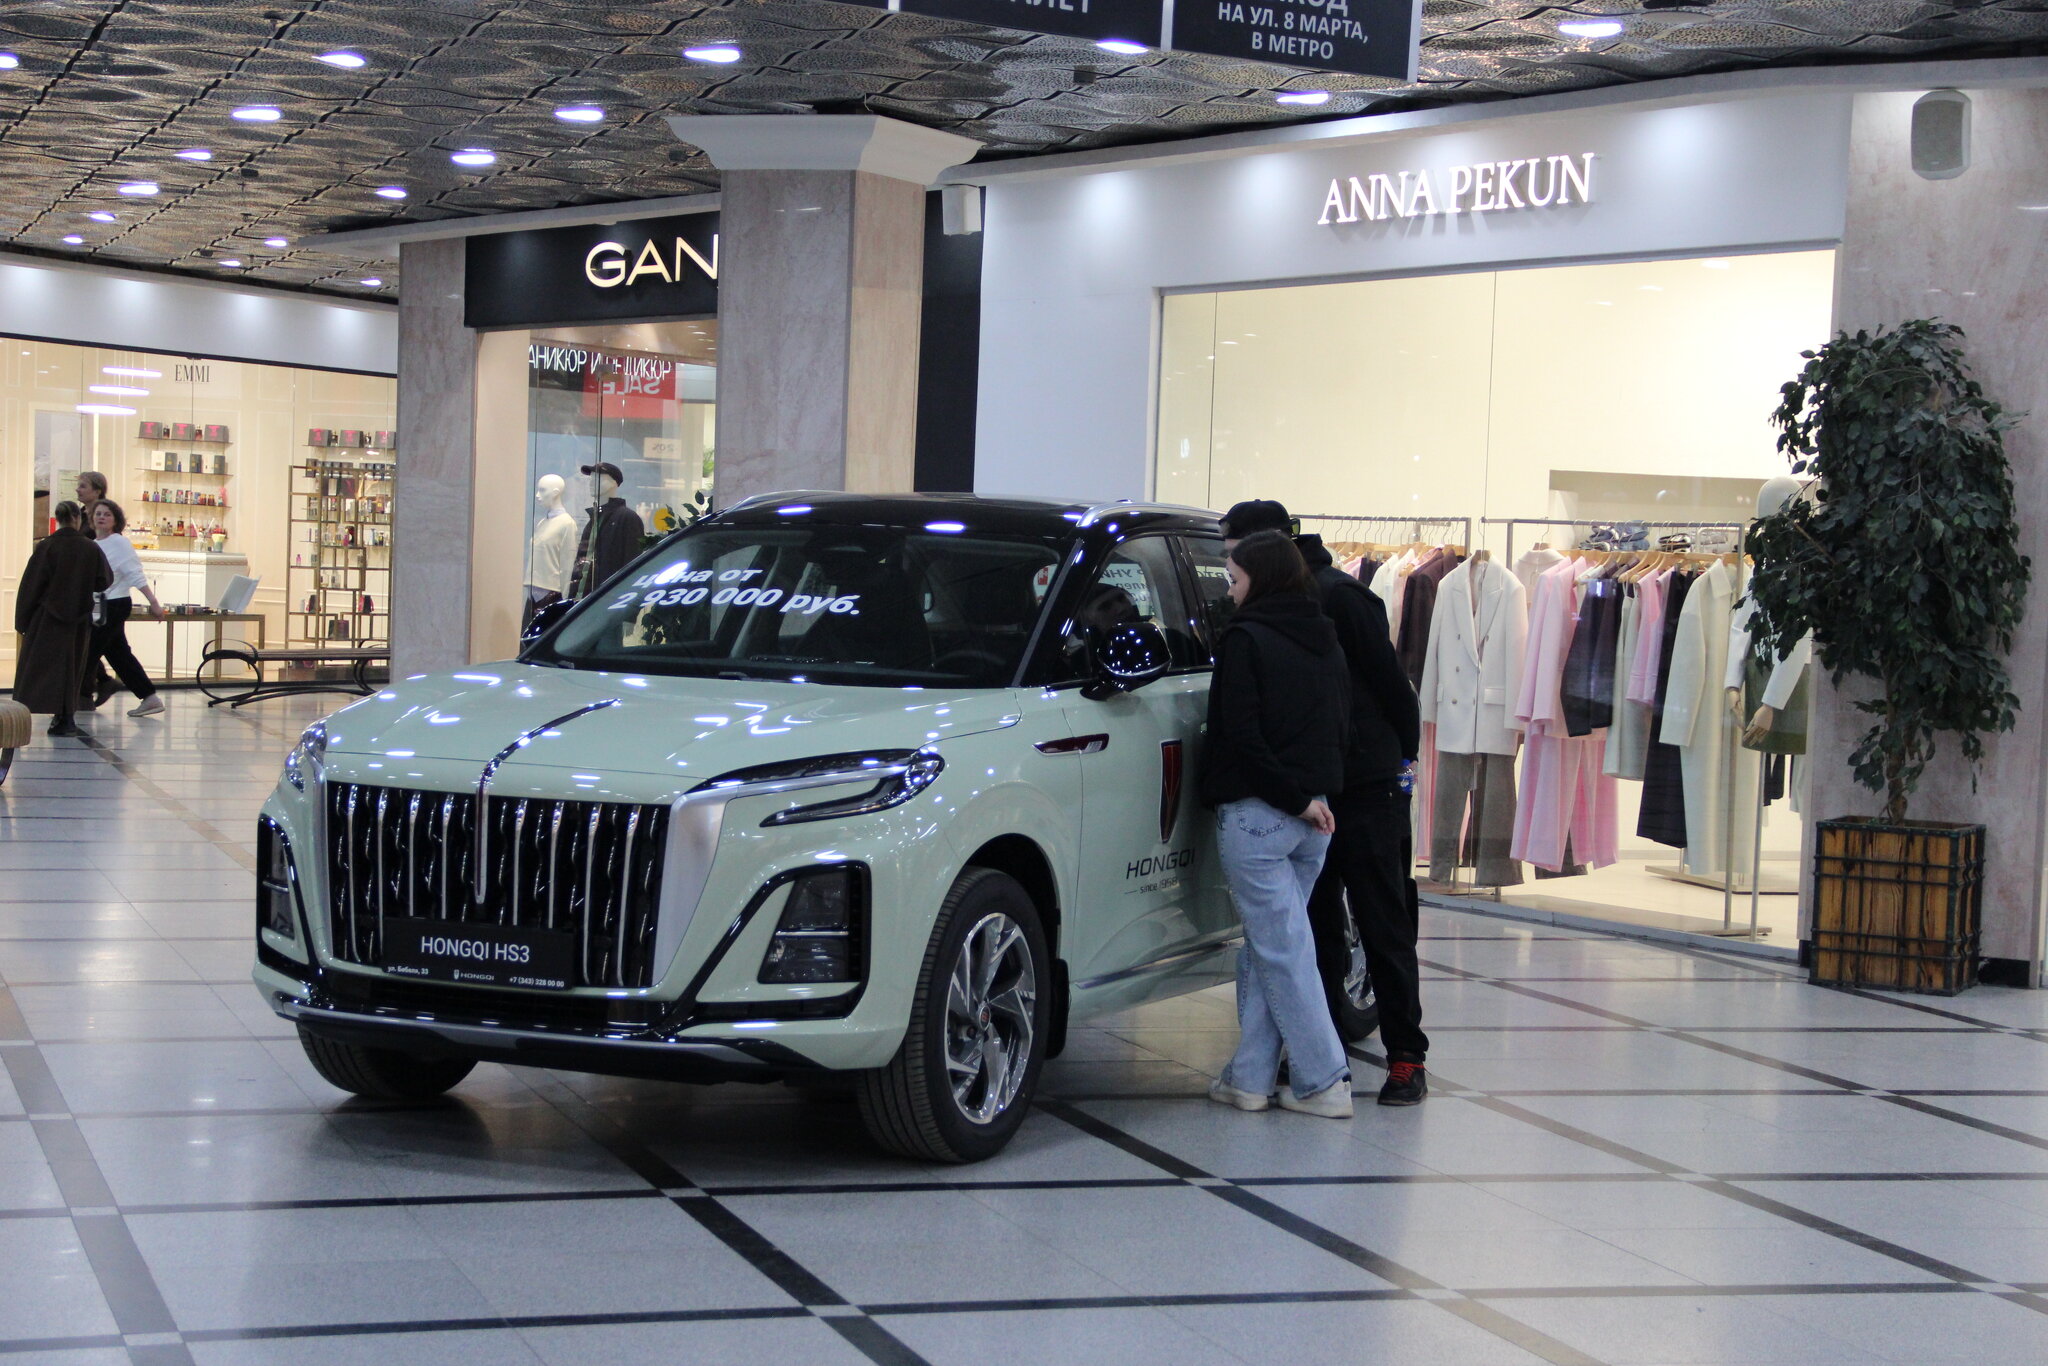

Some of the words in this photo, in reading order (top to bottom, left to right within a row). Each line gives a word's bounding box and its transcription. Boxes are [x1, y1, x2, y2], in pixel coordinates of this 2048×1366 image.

[1218, 2, 1244, 23] НА
[1250, 6, 1278, 28] УЛ.
[1284, 11, 1294, 30] 8
[1300, 13, 1369, 44] МАРТА,
[1252, 31, 1263, 50] В
[1269, 33, 1334, 60] МЕТРО
[1317, 168, 1438, 225] ANNA
[1446, 152, 1595, 214] PEKUN
[585, 233, 719, 288] GAN
[175, 364, 210, 383] EMMI
[605, 356, 672, 381] ЕДИКЮР
[632, 567, 714, 589] цна
[718, 568, 764, 583] от
[607, 591, 639, 611] 2
[639, 587, 709, 609] 930
[711, 587, 784, 607] 000
[779, 594, 861, 615] руб.
[1125, 847, 1196, 880] HONGQI
[421, 935, 489, 961] HONGQI
[494, 942, 530, 963] HS3
[460, 972, 494, 981] HONGQI
[547, 979, 555, 987] 00
[556, 980, 565, 988] 00
